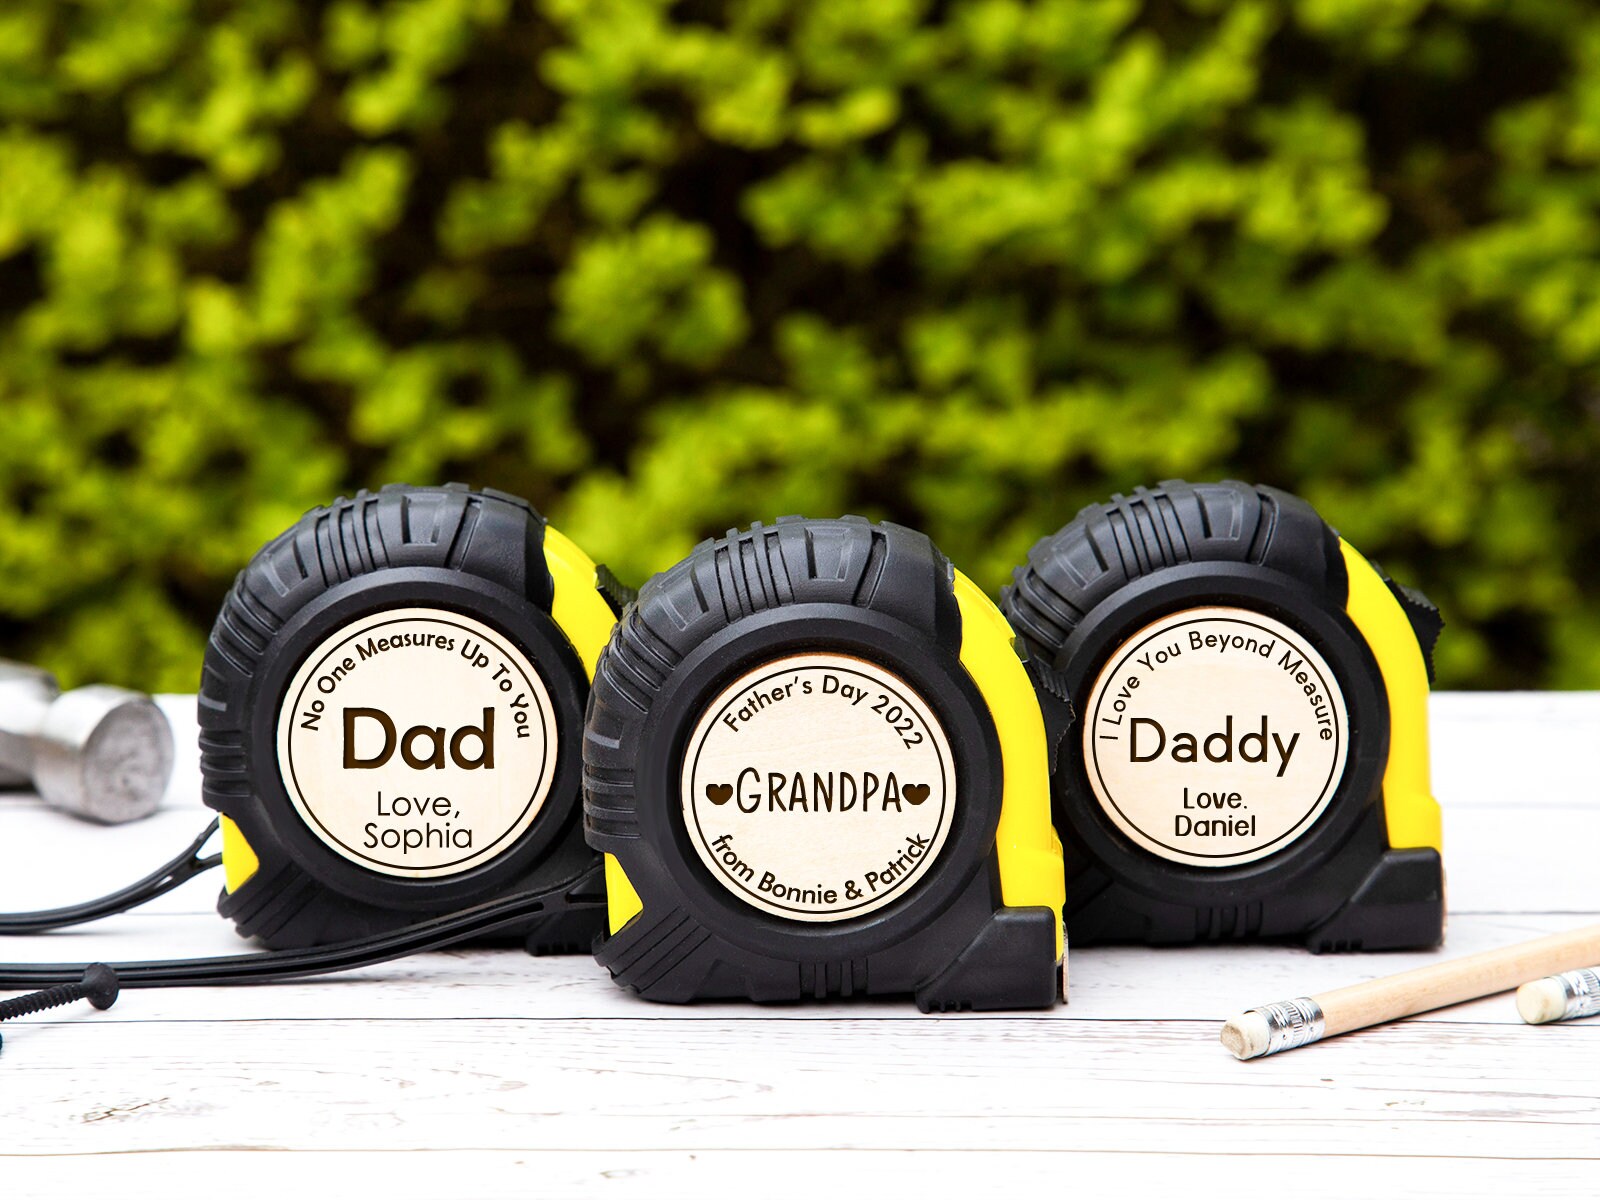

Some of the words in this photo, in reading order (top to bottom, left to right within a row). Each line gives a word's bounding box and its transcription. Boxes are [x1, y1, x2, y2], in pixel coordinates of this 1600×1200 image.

[301, 700, 325, 731] No
[317, 658, 356, 693] One
[355, 633, 455, 661] Measures
[460, 639, 489, 669] Up
[492, 663, 512, 692] To
[510, 693, 530, 738] You
[723, 676, 812, 732] Father's
[822, 675, 869, 706] Day
[871, 694, 923, 749] 2022
[1102, 676, 1140, 725] Love
[1137, 643, 1181, 671] You
[1189, 631, 1275, 658] Beyond
[1278, 650, 1332, 741] Measure
[343, 707, 495, 770] Dad
[1130, 715, 1300, 777] Daddy
[377, 791, 460, 818] Love,
[737, 767, 902, 813] GRANDPA
[363, 822, 472, 854] Sophia
[1175, 815, 1256, 836] Daniel
[712, 834, 754, 882] from
[758, 871, 837, 904] Bonnie
[845, 880, 864, 900] &
[865, 834, 930, 891] Patrick
